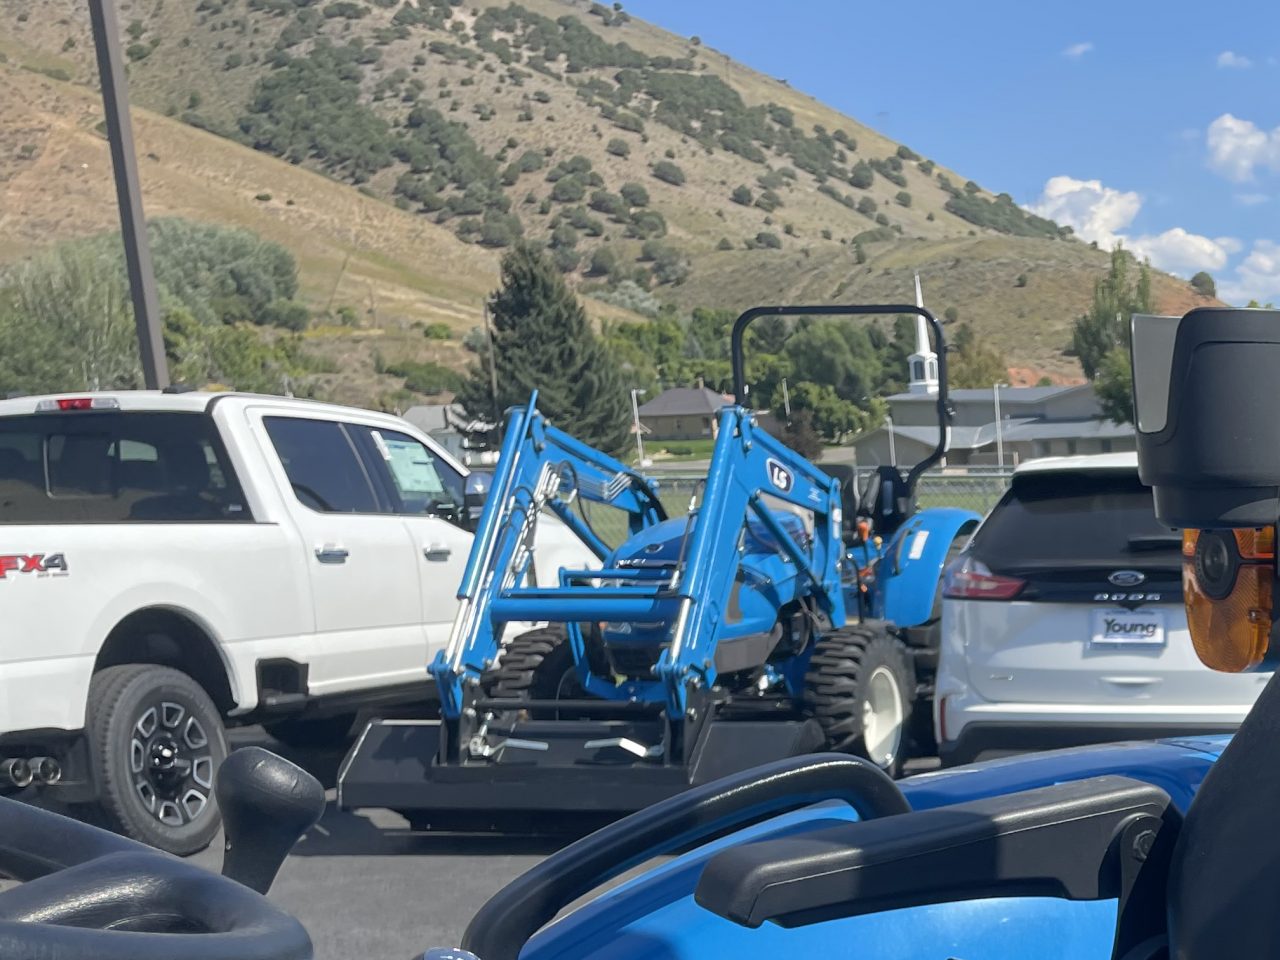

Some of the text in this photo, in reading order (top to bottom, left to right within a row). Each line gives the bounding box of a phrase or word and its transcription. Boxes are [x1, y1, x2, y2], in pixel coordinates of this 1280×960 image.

[773, 466, 787, 489] LS
[0, 554, 68, 578] FX4
[1104, 618, 1157, 638] Young
